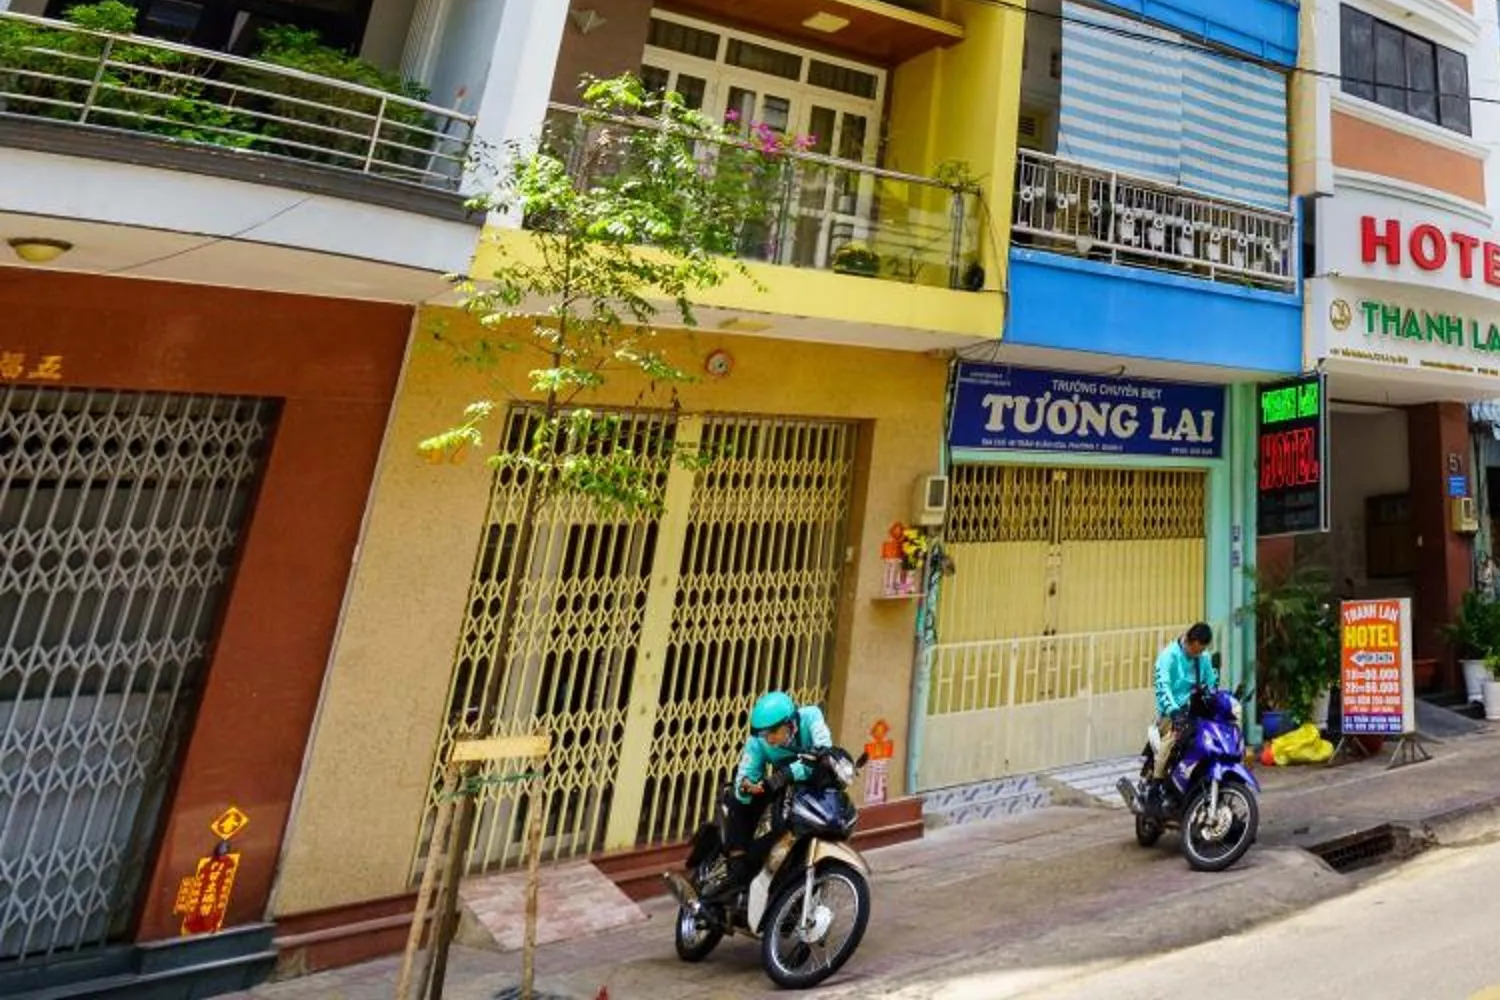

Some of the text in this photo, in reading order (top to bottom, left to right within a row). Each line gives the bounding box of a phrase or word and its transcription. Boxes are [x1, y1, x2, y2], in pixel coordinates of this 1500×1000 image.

[1362, 301, 1464, 347] THANH
[982, 391, 1215, 442] TƯƠNG LAI
[1344, 624, 1399, 649] HOTEL
